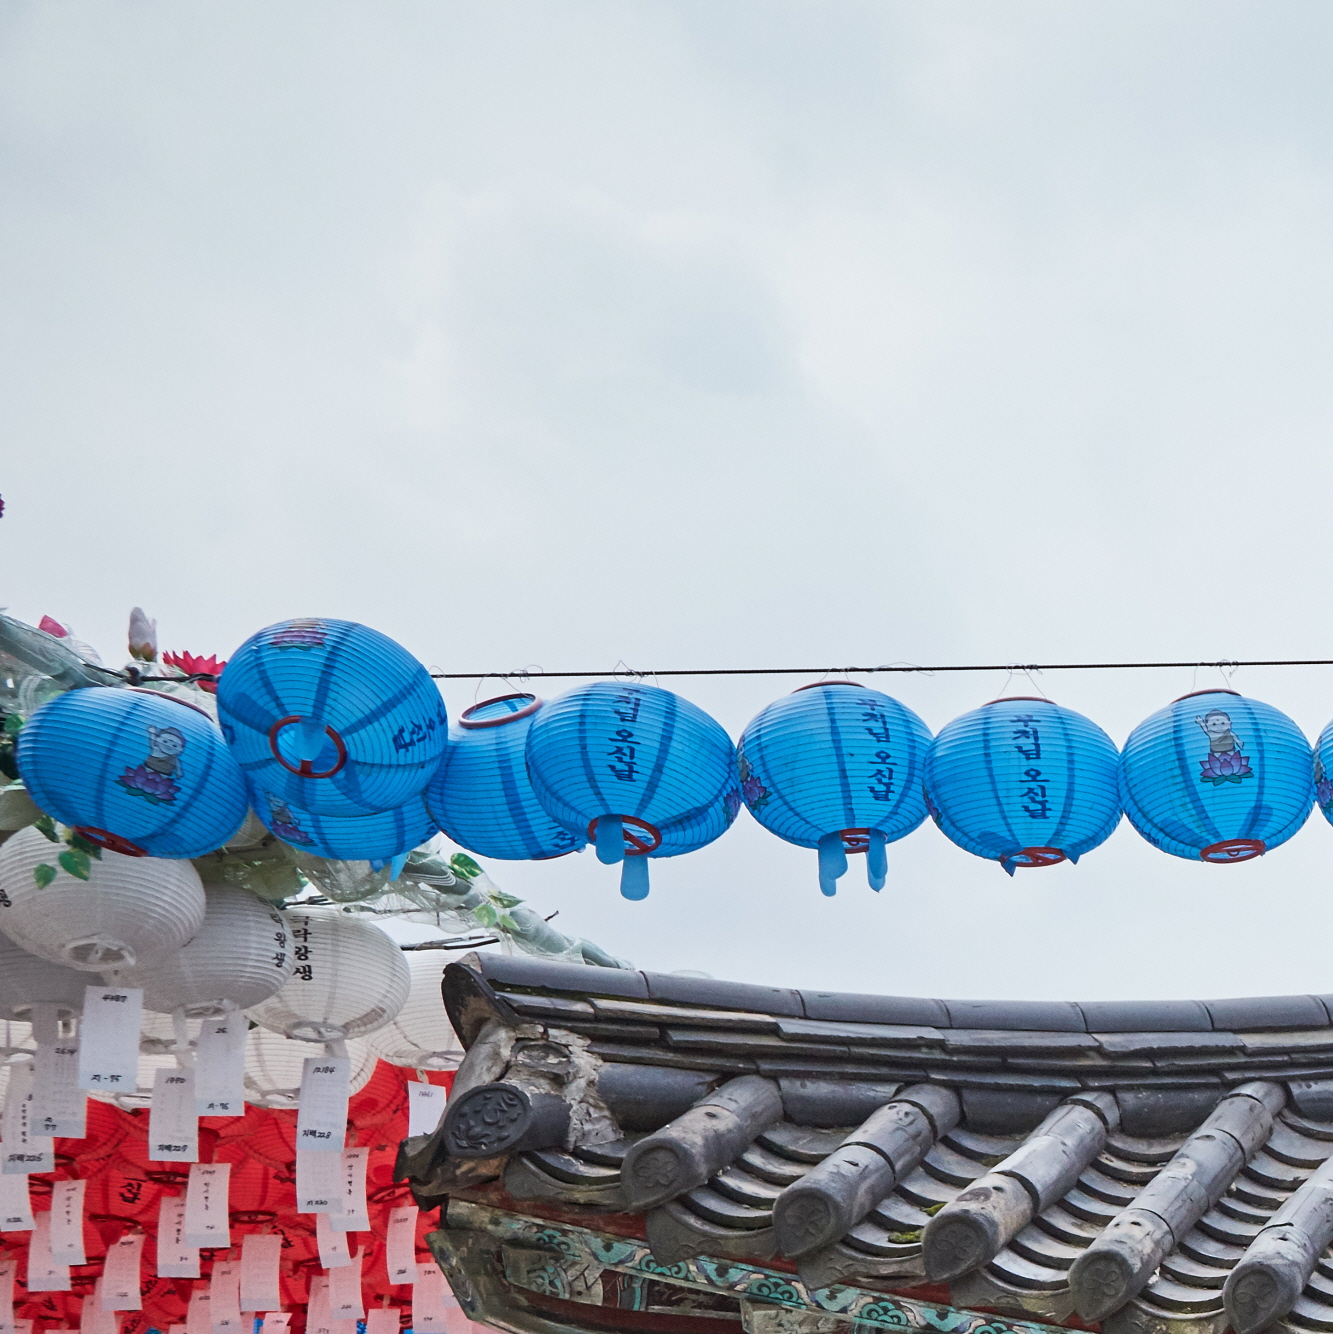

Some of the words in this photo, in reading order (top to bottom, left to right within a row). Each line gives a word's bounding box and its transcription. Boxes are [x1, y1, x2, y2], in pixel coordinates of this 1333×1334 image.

[855, 698, 892, 744] 부처님
[1013, 714, 1042, 760] 부처님
[607, 728, 643, 783] 오신날
[866, 750, 899, 801] 오신날
[1018, 766, 1051, 820] 오신날
[120, 1177, 147, 1204] 신날
